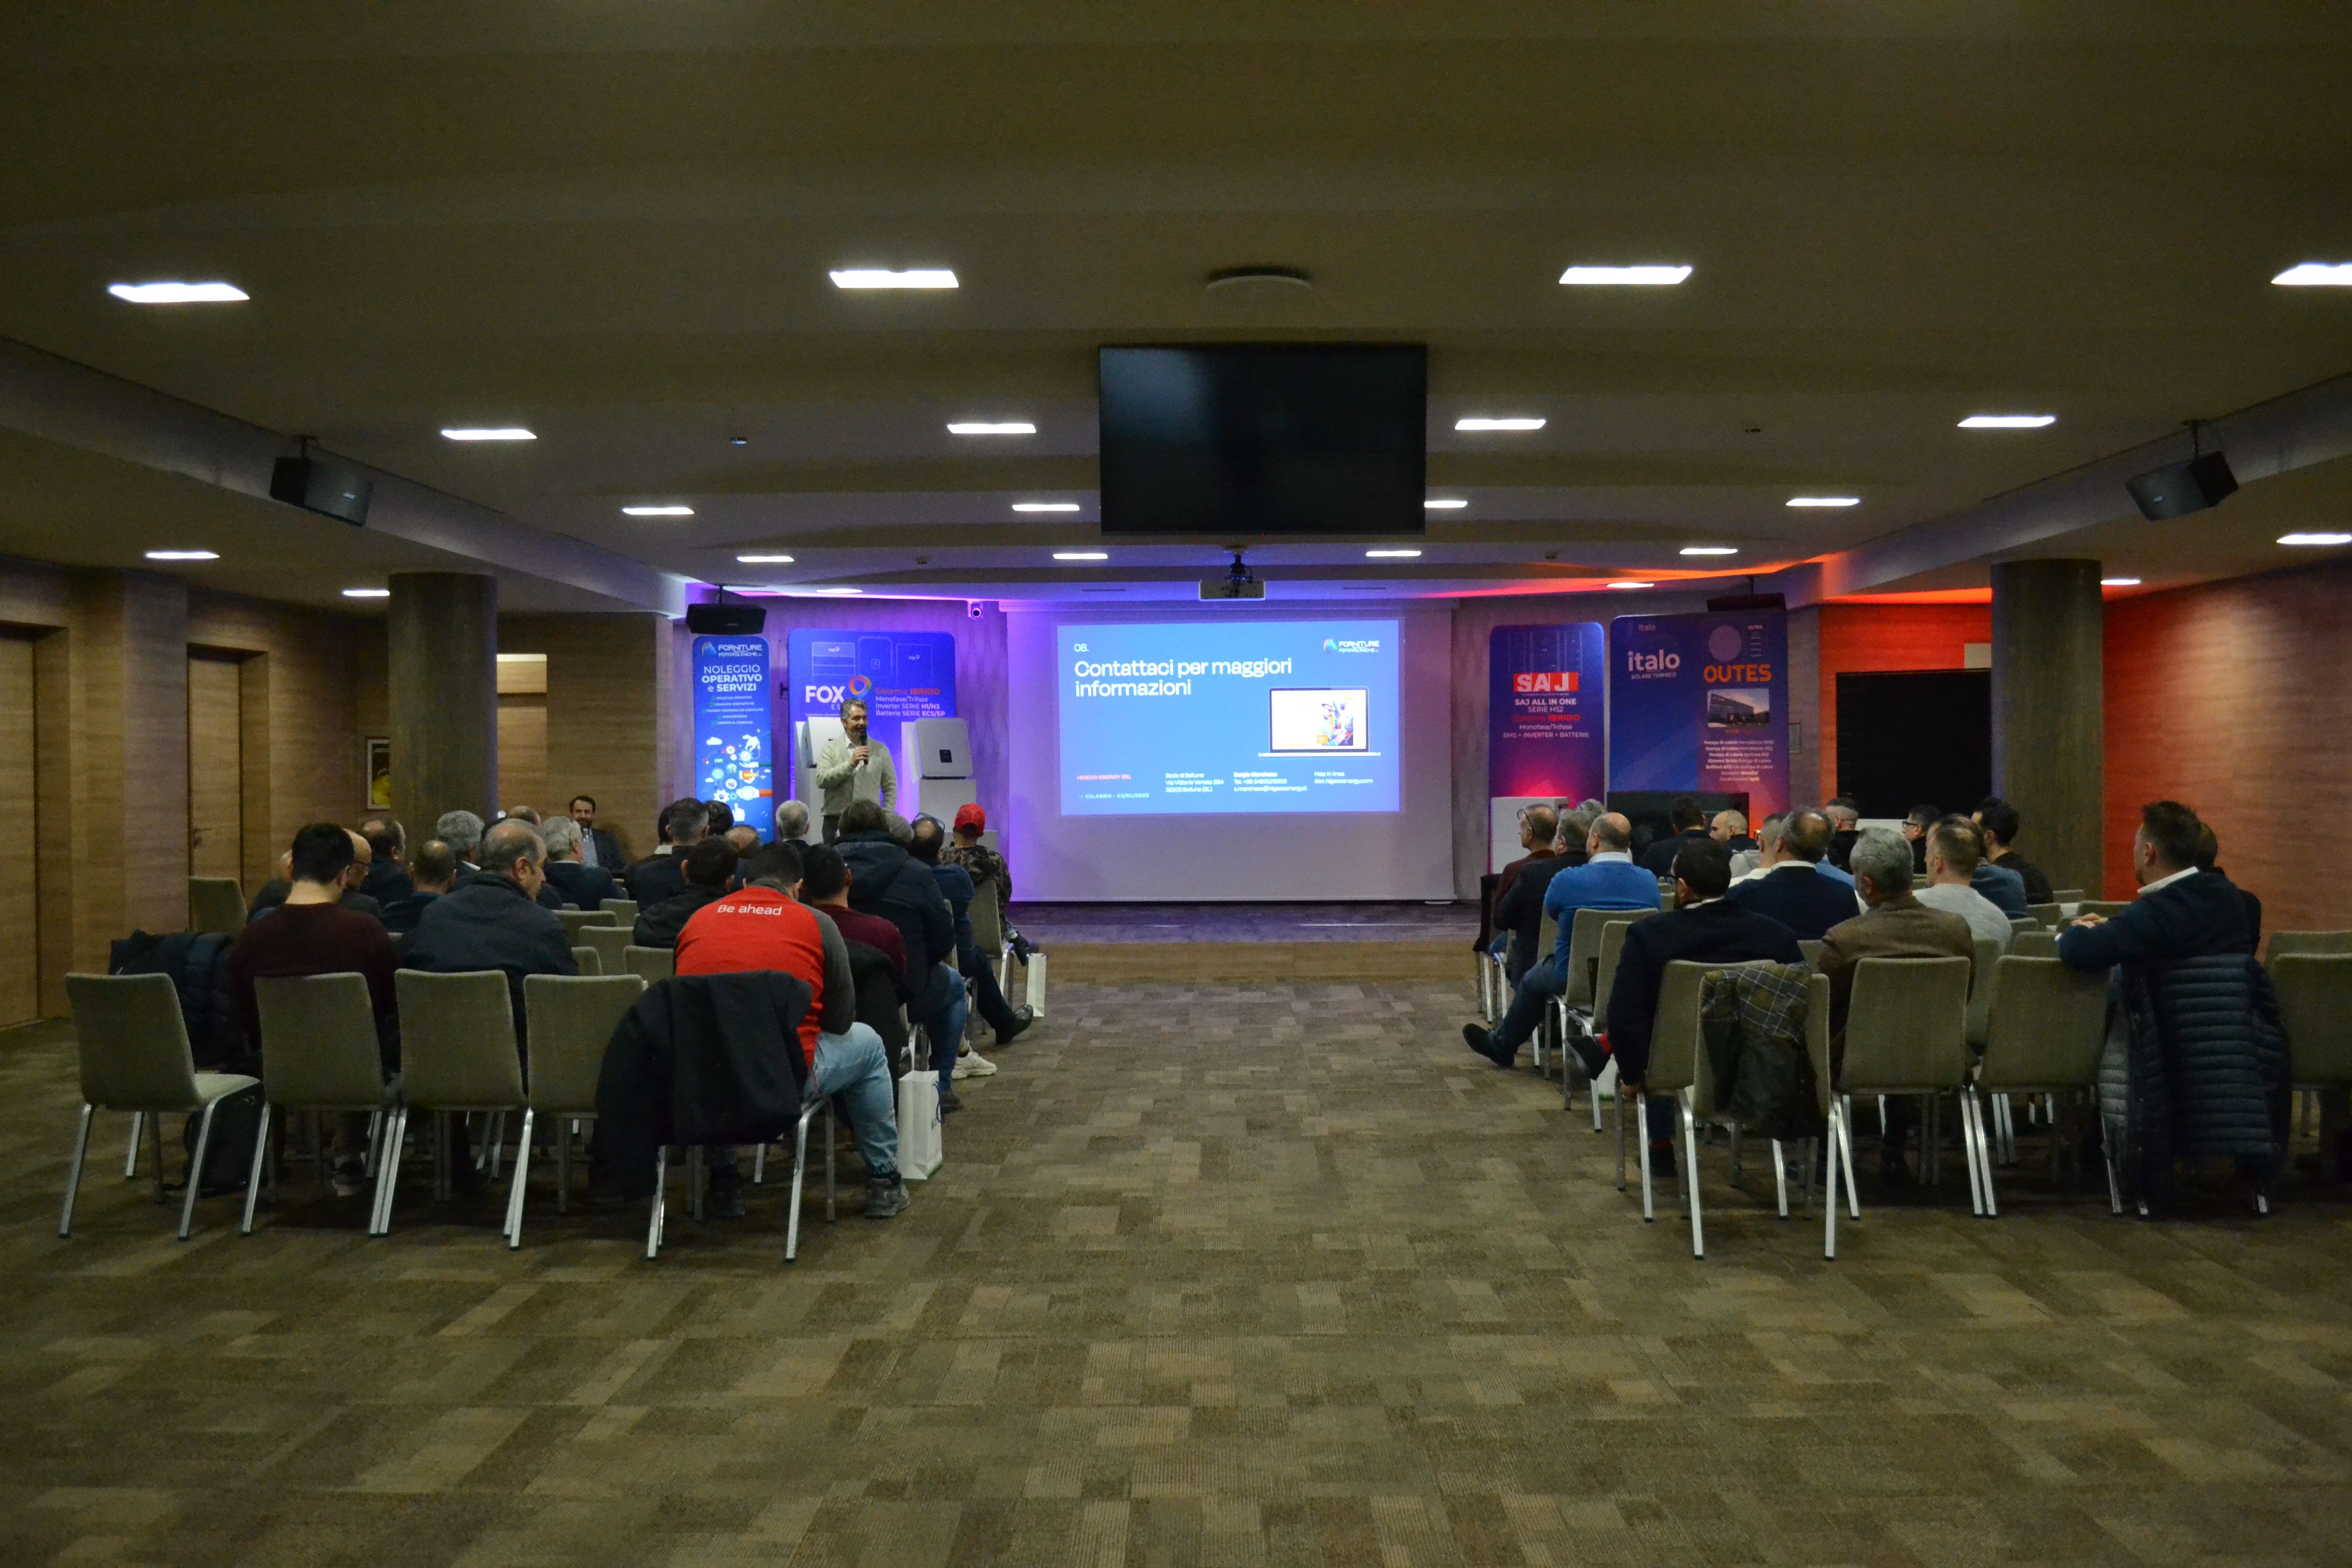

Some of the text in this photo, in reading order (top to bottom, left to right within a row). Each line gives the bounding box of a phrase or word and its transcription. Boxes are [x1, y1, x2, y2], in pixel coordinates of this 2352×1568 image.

[1074, 643, 1089, 652] 08.
[1074, 658, 1292, 678] Contattaci per maggiori
[1628, 649, 1680, 671] italo
[701, 674, 763, 683] OPERATIVO
[704, 665, 760, 674] NOLEGGIO
[1703, 664, 1772, 683] OUTES
[717, 683, 756, 692] SERVIZI
[1075, 679, 1191, 697] informazioni
[1517, 672, 1569, 692] SAJ
[805, 685, 845, 703] FOX
[717, 904, 782, 915] Be ahead
